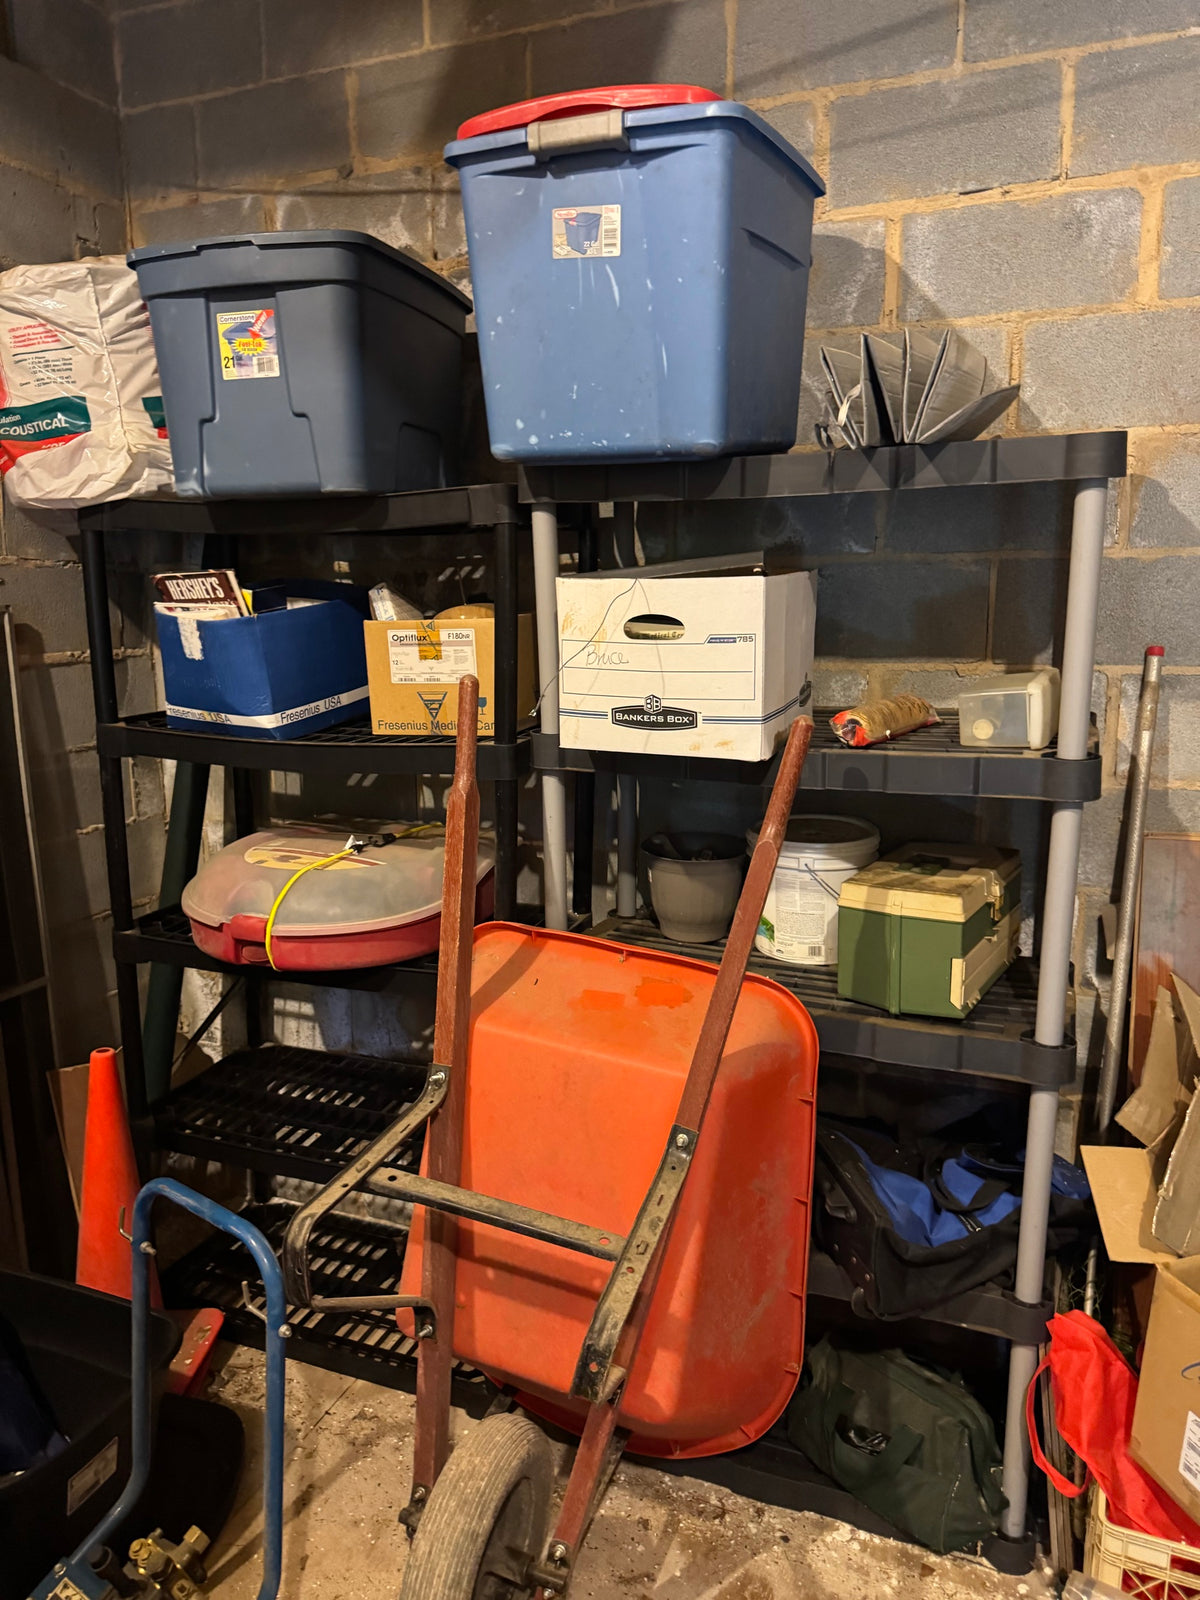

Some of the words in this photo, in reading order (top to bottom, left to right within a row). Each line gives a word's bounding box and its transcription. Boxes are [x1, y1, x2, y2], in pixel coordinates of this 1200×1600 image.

[220, 314, 255, 323] Cornerstone
[223, 356, 236, 369] 21
[165, 576, 225, 600] HERSHEY'S
[391, 633, 428, 643] Optiflux
[736, 635, 754, 643] 785
[586, 643, 629, 666] Bruce
[167, 707, 207, 720] resenius
[209, 711, 232, 724] USA
[280, 704, 321, 724] Fresenius
[324, 695, 342, 710] USA
[615, 712, 664, 723] BANKERS
[377, 719, 428, 731] Fresenius
[430, 719, 457, 731] Medi
[477, 719, 495, 731] Car
